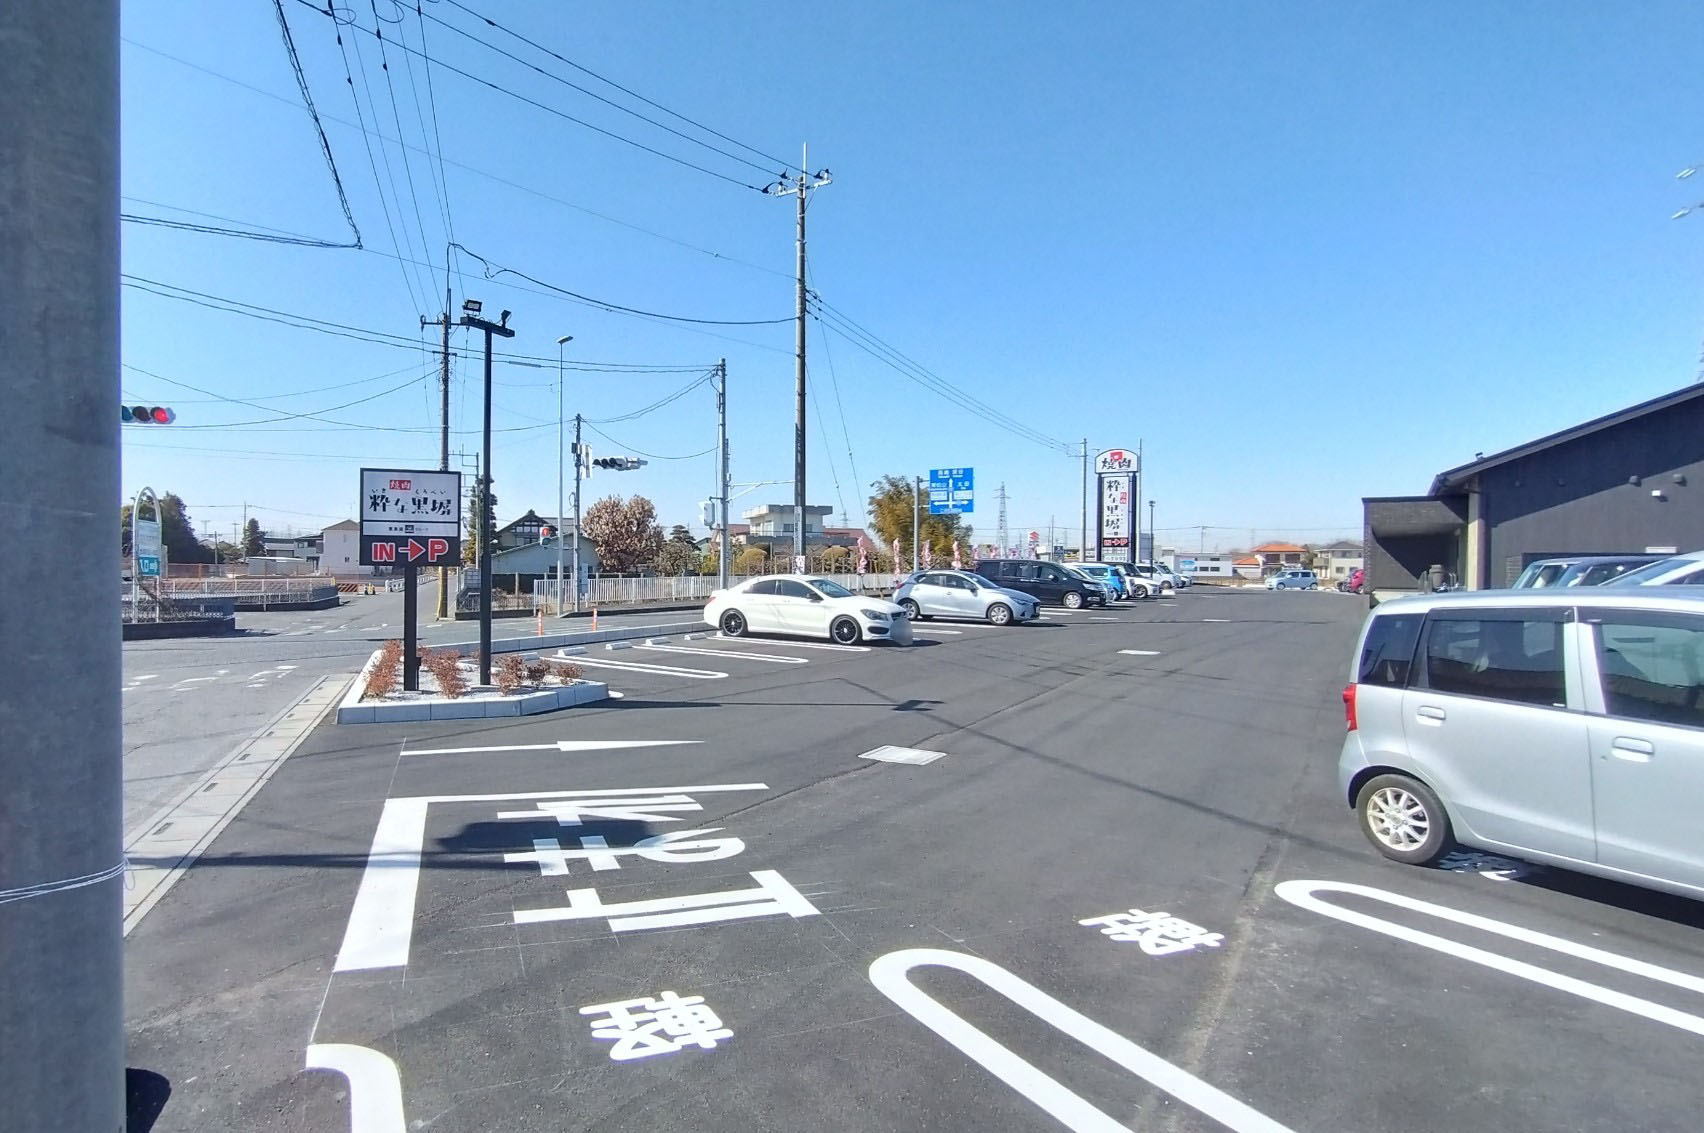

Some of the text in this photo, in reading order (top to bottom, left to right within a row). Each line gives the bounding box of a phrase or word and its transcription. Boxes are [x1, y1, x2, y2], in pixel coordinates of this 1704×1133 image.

[1102, 458, 1132, 470] 焼肉
[372, 538, 449, 563] IN P
[497, 795, 821, 932] 止まれ
[1078, 908, 1226, 956] 軽
[579, 990, 734, 1062] 軽
